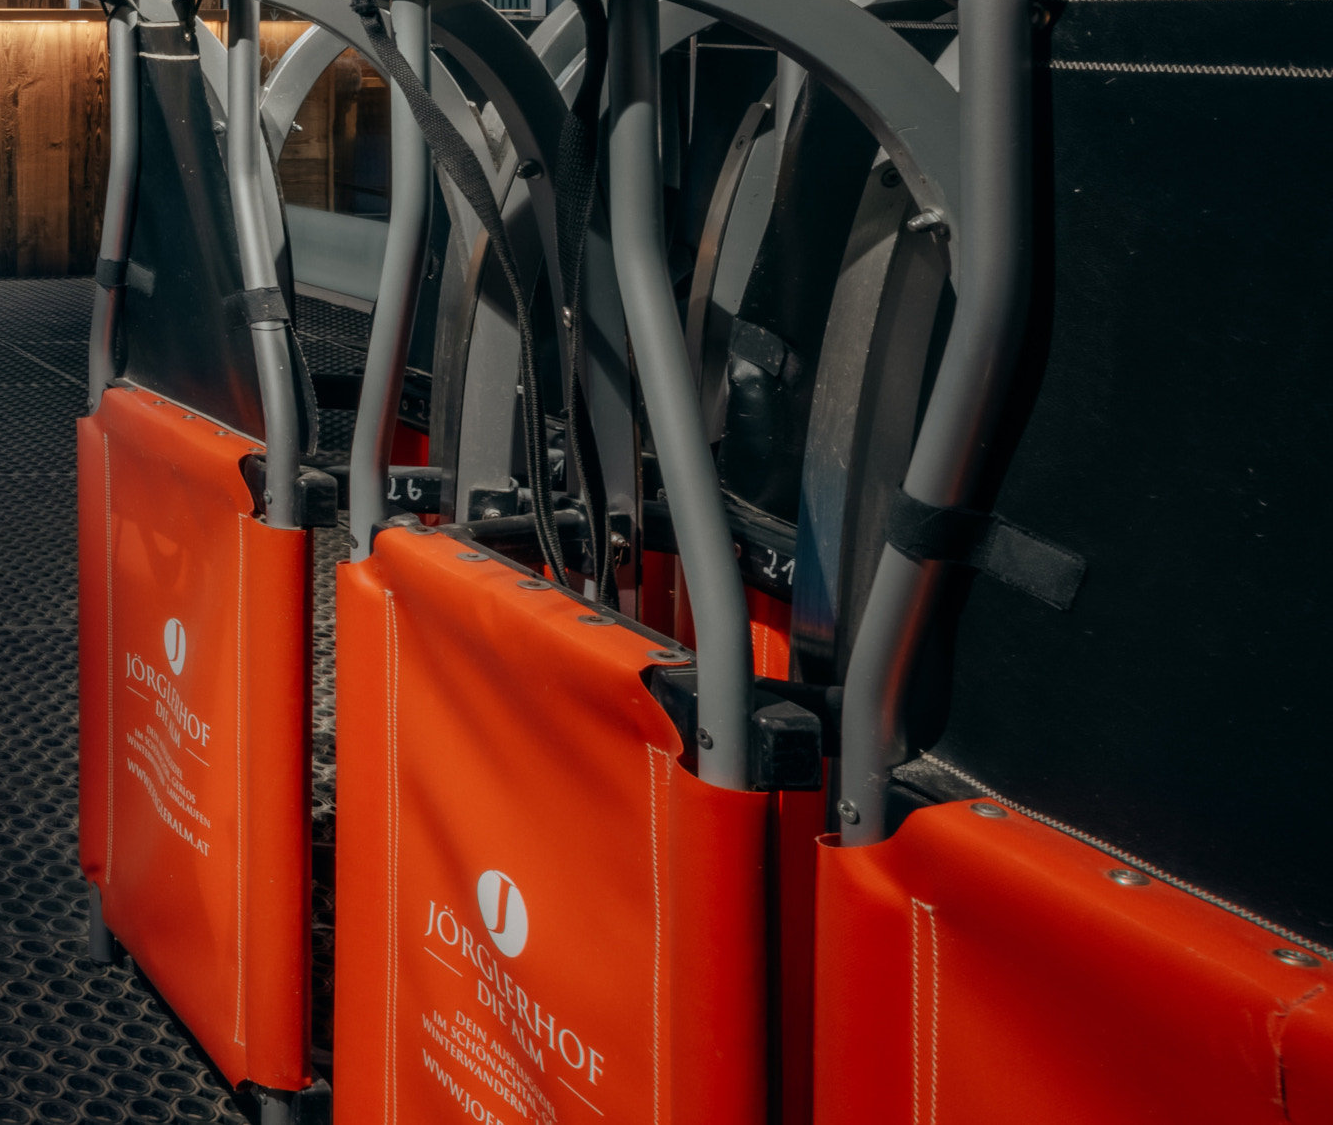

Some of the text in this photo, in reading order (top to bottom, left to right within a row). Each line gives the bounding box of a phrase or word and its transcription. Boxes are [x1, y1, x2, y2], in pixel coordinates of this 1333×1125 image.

[126, 652, 210, 747] JÖRGLERHOF
[156, 699, 169, 728] DIE
[135, 728, 143, 741] IM
[171, 776, 196, 805] GERLOS
[166, 784, 211, 829] LANGLAUFEN
[425, 900, 604, 1086] JÖRGLERHOF
[478, 979, 545, 1073] DIE ALM
[422, 1013, 528, 1119] WINTERWANDERN
[433, 1010, 540, 1117] IM SCHÖNACHTAL
[456, 1011, 557, 1122] DEIN AUSFLUGSZIEL
